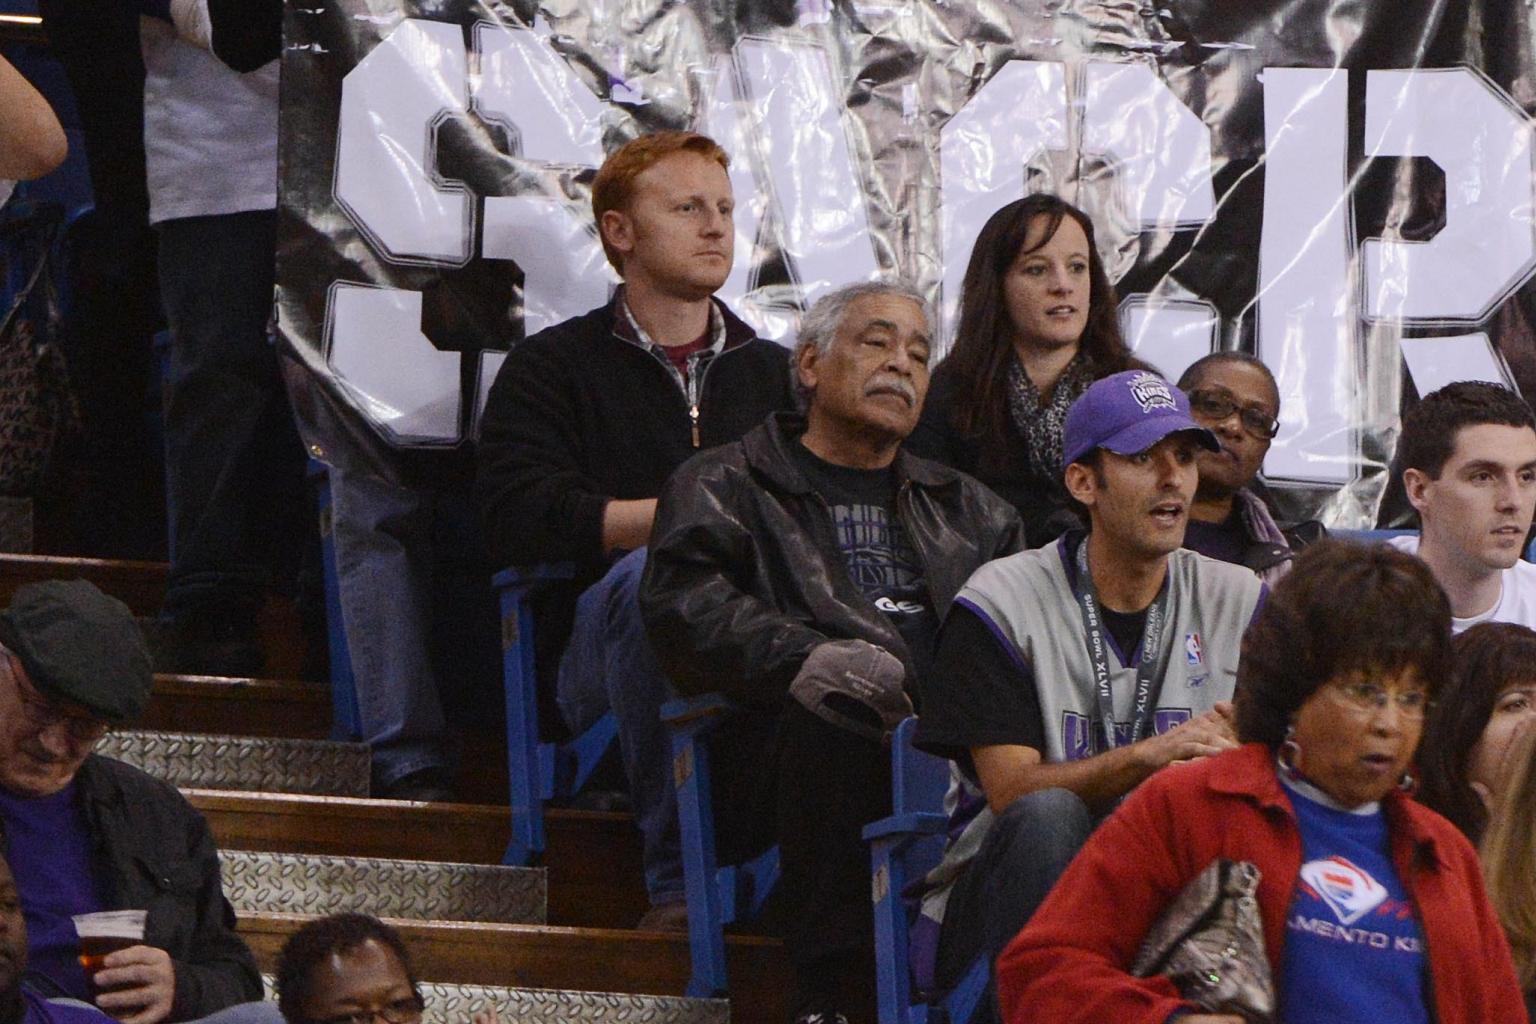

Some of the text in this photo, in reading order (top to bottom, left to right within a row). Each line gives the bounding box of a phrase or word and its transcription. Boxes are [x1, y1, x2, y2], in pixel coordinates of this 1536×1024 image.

[1083, 593, 1098, 628] SUPER
[1092, 629, 1103, 660] BOWL
[1096, 661, 1111, 698] XLVII
[1135, 678, 1151, 714] XLVII
